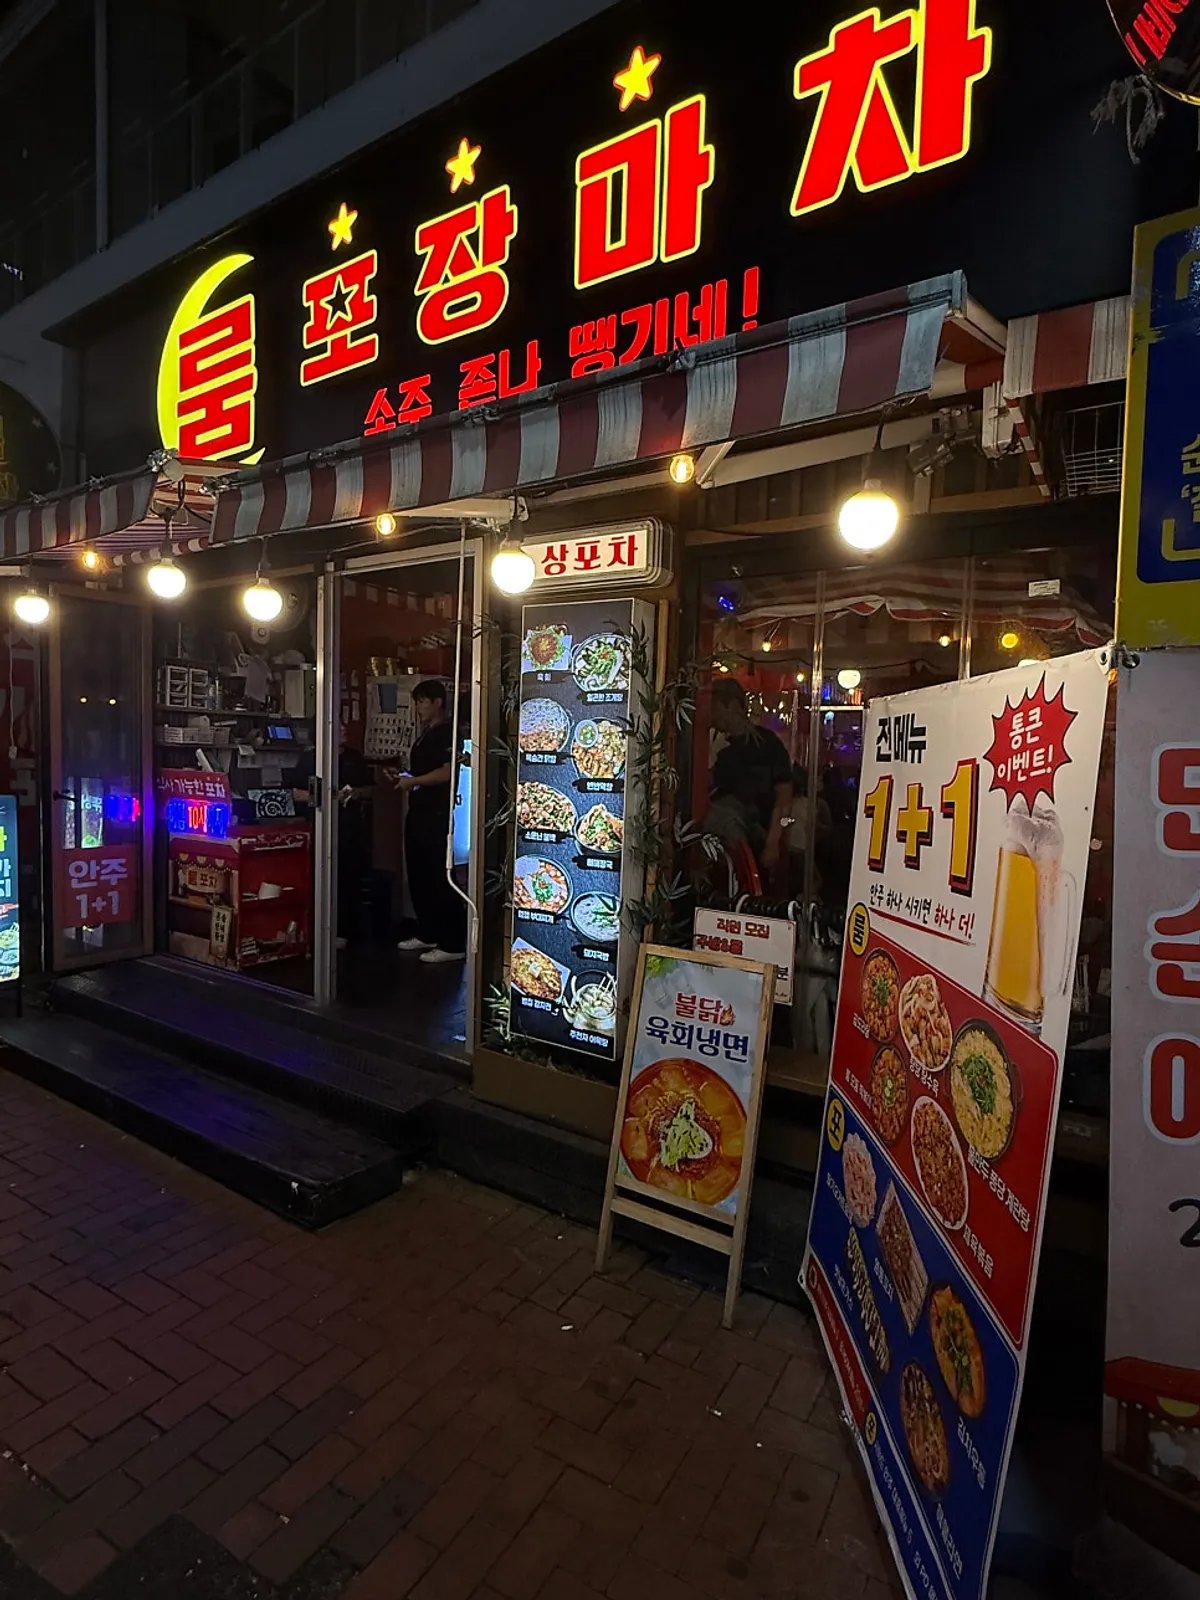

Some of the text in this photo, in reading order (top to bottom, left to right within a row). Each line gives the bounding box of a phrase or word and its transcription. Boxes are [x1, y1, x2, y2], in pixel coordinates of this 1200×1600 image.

[363, 374, 433, 437] 소주
[458, 340, 542, 410] 존나
[541, 534, 638, 576] 상포차
[876, 713, 927, 763] 전메뉴
[1009, 707, 1043, 749] 통큰
[997, 745, 1054, 782] 이벤트!
[174, 778, 204, 796] 가능한
[864, 758, 980, 898] 1+1
[68, 858, 128, 889] 안주
[76, 891, 119, 919] 1+1
[869, 884, 976, 939] 안주 하나 시키면 하나 더!
[744, 921, 769, 939] 모집
[853, 912, 867, 948] 룸
[675, 992, 724, 1025] 불닭
[645, 1015, 749, 1063] 육회냉면
